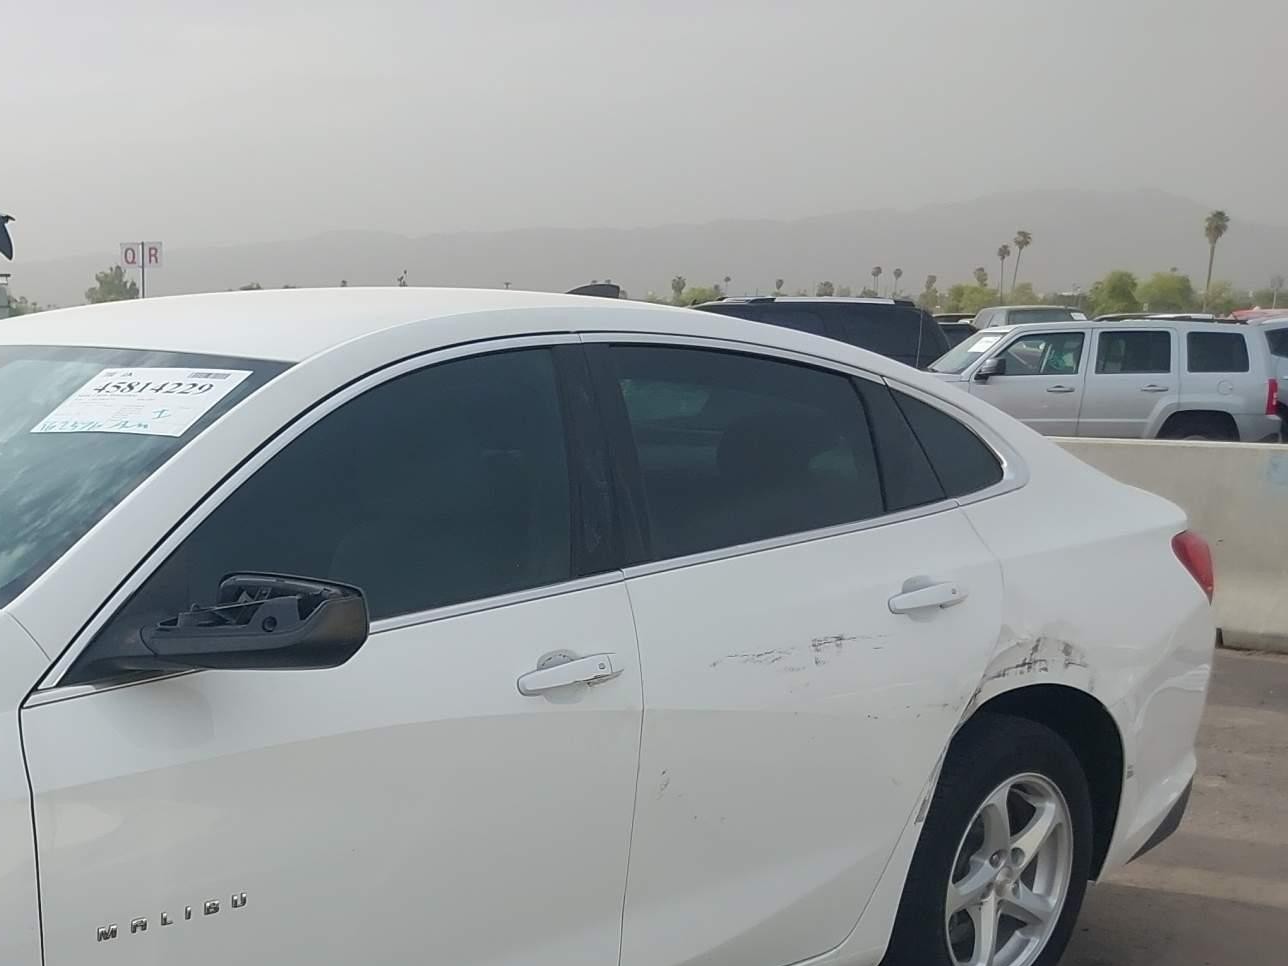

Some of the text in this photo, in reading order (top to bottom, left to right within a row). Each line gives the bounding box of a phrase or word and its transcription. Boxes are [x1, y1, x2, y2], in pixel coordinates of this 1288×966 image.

[124, 247, 137, 265] Q
[148, 246, 159, 264] R
[93, 380, 214, 395] 45814229
[97, 892, 247, 942] MALIBU
